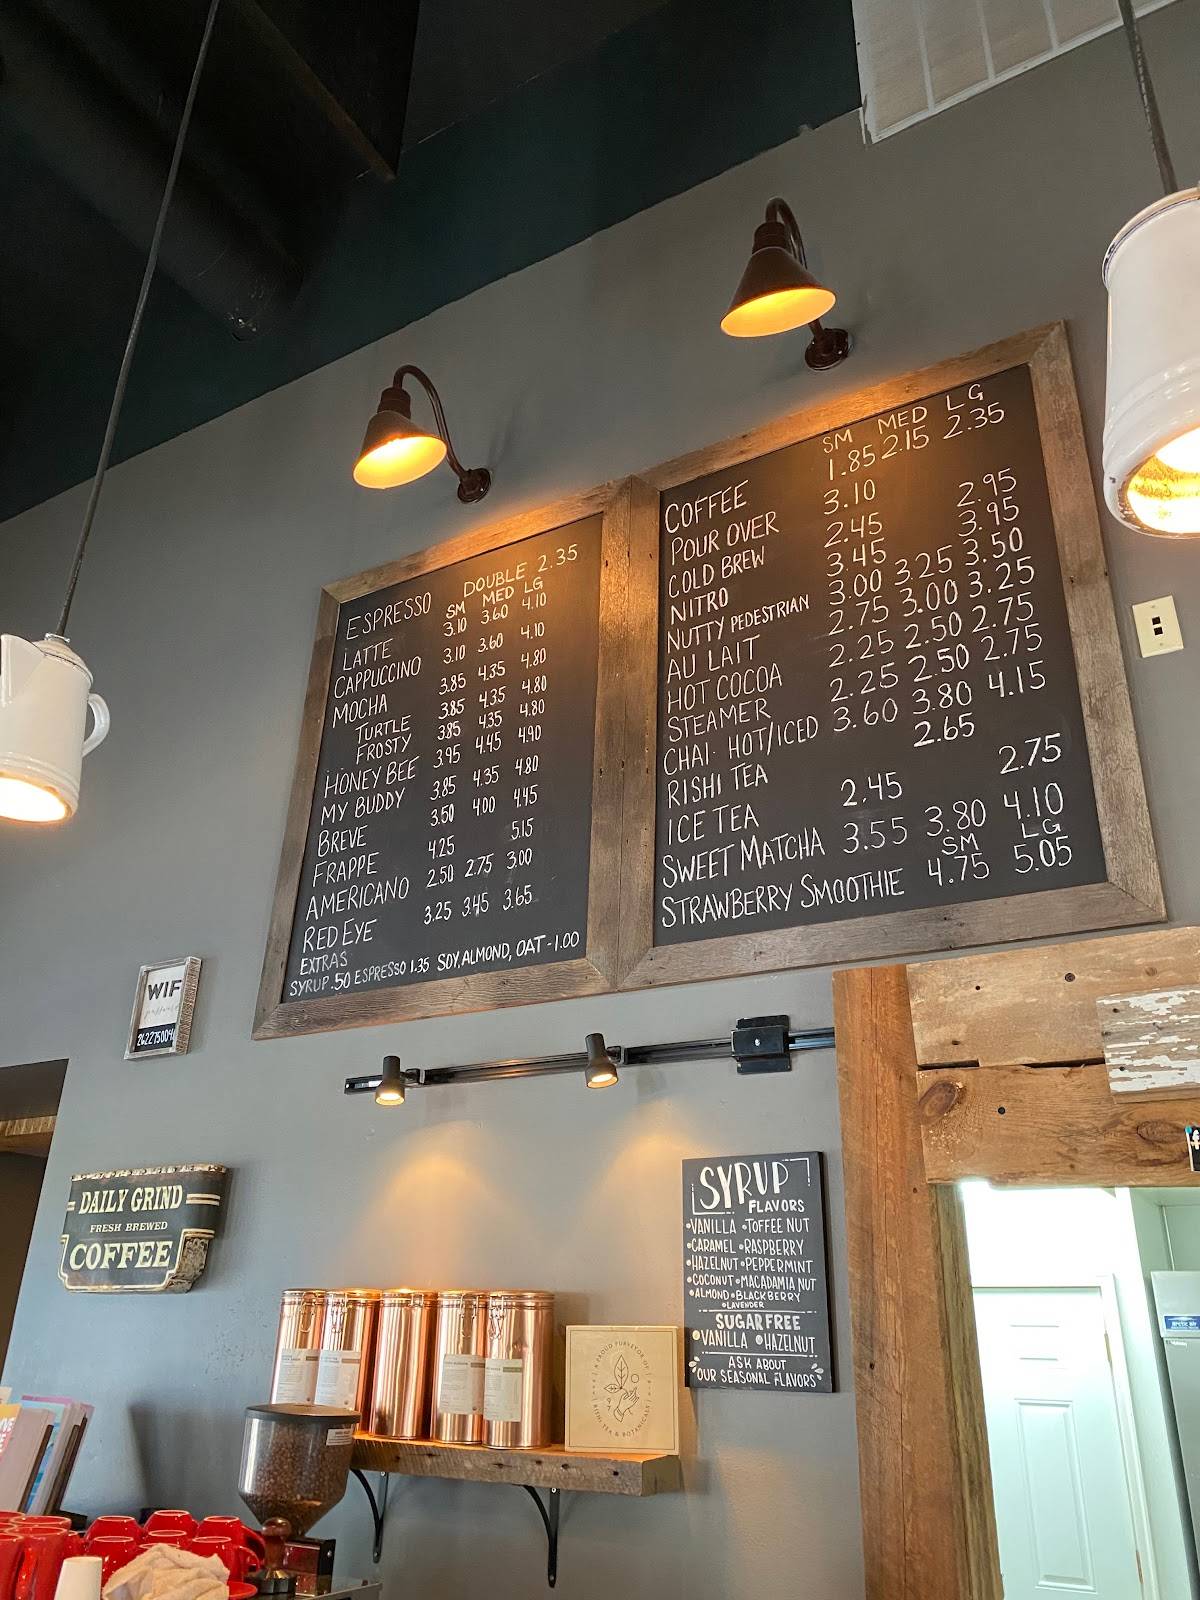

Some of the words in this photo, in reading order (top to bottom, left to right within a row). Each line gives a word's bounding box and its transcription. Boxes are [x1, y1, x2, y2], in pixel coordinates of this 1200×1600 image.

[822, 429, 853, 453] SM
[878, 406, 928, 434] MED
[946, 384, 984, 411] LG
[665, 480, 749, 534] COFFEE
[829, 445, 876, 481] 1.85
[881, 425, 930, 459] 2.15
[943, 402, 1005, 440] 2.35
[668, 564, 714, 598] COLD
[721, 546, 765, 579] BREW
[824, 512, 883, 548] 2.45
[957, 468, 1017, 507] 2.95
[671, 530, 720, 566] POUR
[727, 511, 779, 547] OVER
[823, 479, 876, 515] 3.10
[347, 592, 432, 640] ESPRESSO
[463, 562, 526, 598] DOUBLE
[538, 544, 578, 573] 2.35
[667, 616, 724, 654] NUTTY
[731, 594, 810, 632] PEDESTRIAN
[828, 569, 882, 605] 3.00
[894, 545, 952, 586] 3.25
[962, 527, 1023, 566] 3.50
[671, 587, 729, 625] NITRO
[827, 537, 887, 576] 3.45
[958, 496, 1019, 537] 3.95
[343, 638, 394, 671] LATTE
[443, 618, 467, 636] 3.10
[481, 604, 509, 624] 3.60
[522, 592, 547, 611] 4.10
[446, 601, 466, 619] SM
[482, 587, 514, 607] MED
[524, 576, 543, 594] LG
[667, 654, 696, 684] AU
[708, 634, 761, 671] LAIT
[829, 596, 889, 636] 2.75
[900, 579, 959, 617] 3.00
[967, 556, 1035, 598] 3.25
[334, 656, 421, 698] CAPPUCCINO
[443, 645, 466, 664] 3.10
[478, 633, 504, 652] 3.60
[521, 622, 544, 640] 4.10
[667, 680, 711, 714] HOT
[717, 663, 783, 701] COCOA
[829, 630, 894, 668] 2.25
[905, 611, 962, 649] 2.50
[972, 592, 1034, 633] 2.75
[668, 702, 771, 742] STEAMER
[830, 662, 898, 702] 2.25
[908, 644, 970, 682] 2.50
[981, 623, 1042, 662] 2.75
[332, 694, 388, 728] MOCHA
[521, 648, 546, 668] 4.80
[355, 715, 411, 744] TURTLE
[522, 676, 547, 694] 4.80
[728, 716, 818, 759] HOT/ICED
[833, 698, 898, 732] 3.60
[912, 681, 972, 715] 3.80
[989, 660, 1046, 697] 4.15
[324, 766, 383, 798] HONEY
[386, 756, 420, 783] BEE
[475, 733, 502, 754] 4.45
[518, 726, 542, 743] 4.90
[356, 734, 412, 764] FROSTY
[520, 699, 545, 717] 4.80
[668, 773, 722, 808] RISHI
[731, 762, 769, 790] TEA
[914, 712, 975, 747] 2.65
[321, 802, 347, 825] MY
[354, 788, 406, 819] BUDDY
[430, 776, 456, 800] 3.85
[473, 765, 499, 788] 4.35
[668, 810, 706, 845] ICE
[713, 804, 759, 834] TEA
[840, 772, 903, 807] 2.45
[999, 733, 1062, 774] 2.75
[313, 852, 380, 887] FRAPPE
[511, 818, 534, 840] 5.15
[317, 825, 368, 857] BREVE
[430, 804, 454, 827] 3.50
[662, 844, 735, 889] SWEET
[740, 827, 825, 871] MATCHA
[843, 817, 908, 854] 3.55
[925, 799, 986, 837] 3.80
[1003, 783, 1064, 820] 4.10
[942, 833, 979, 855] SM
[1021, 819, 1061, 838] LG
[306, 876, 409, 921] AMERICANO
[426, 864, 454, 888] 2.50
[464, 853, 494, 878] 2.75
[507, 848, 533, 870] 3.00
[424, 901, 452, 925] 3.25
[502, 885, 533, 911] 3.65
[662, 883, 793, 928] STRAWBERRY
[800, 868, 905, 908] SMOOTHIE
[928, 852, 990, 886] 4.75
[1014, 836, 1072, 873] 5.05
[290, 979, 329, 997] SYRUP
[354, 958, 406, 985] ESPRESSO
[410, 957, 429, 973] 1.35
[516, 935, 546, 957] OAT
[300, 951, 348, 975] EXTRAS
[79, 1188, 128, 1214] DAILY
[131, 1185, 183, 1212] GRIND
[700, 1162, 789, 1209] SYRUP
[749, 1199, 805, 1213] FLAVORS
[70, 1241, 173, 1270] COFFEE
[90, 1224, 122, 1233] FRESH
[125, 1222, 168, 1232] BREWED
[690, 1218, 736, 1234] VANILLA
[745, 1218, 783, 1233] TOFFEE
[787, 1218, 809, 1233] NUT
[691, 1238, 736, 1253] CARAMEL
[745, 1239, 804, 1256] RASPBERRY
[692, 1255, 738, 1271] HAZELNUT
[746, 1257, 813, 1273] PEPPERMINT
[693, 1275, 734, 1286] COCONUT
[741, 1276, 797, 1290] MACADAMIA
[799, 1279, 816, 1292] NUT
[695, 1290, 729, 1300] ALMOND
[736, 1290, 800, 1302] BLACKBERRY
[701, 1329, 748, 1349] VANILLA
[765, 1335, 815, 1353] HAZELNUT
[728, 1356, 752, 1369] ASK
[757, 1358, 786, 1370] ABOUT
[697, 1368, 716, 1381] OUR
[721, 1370, 770, 1384] SEASONAL
[774, 1373, 816, 1387] FLAVORS
